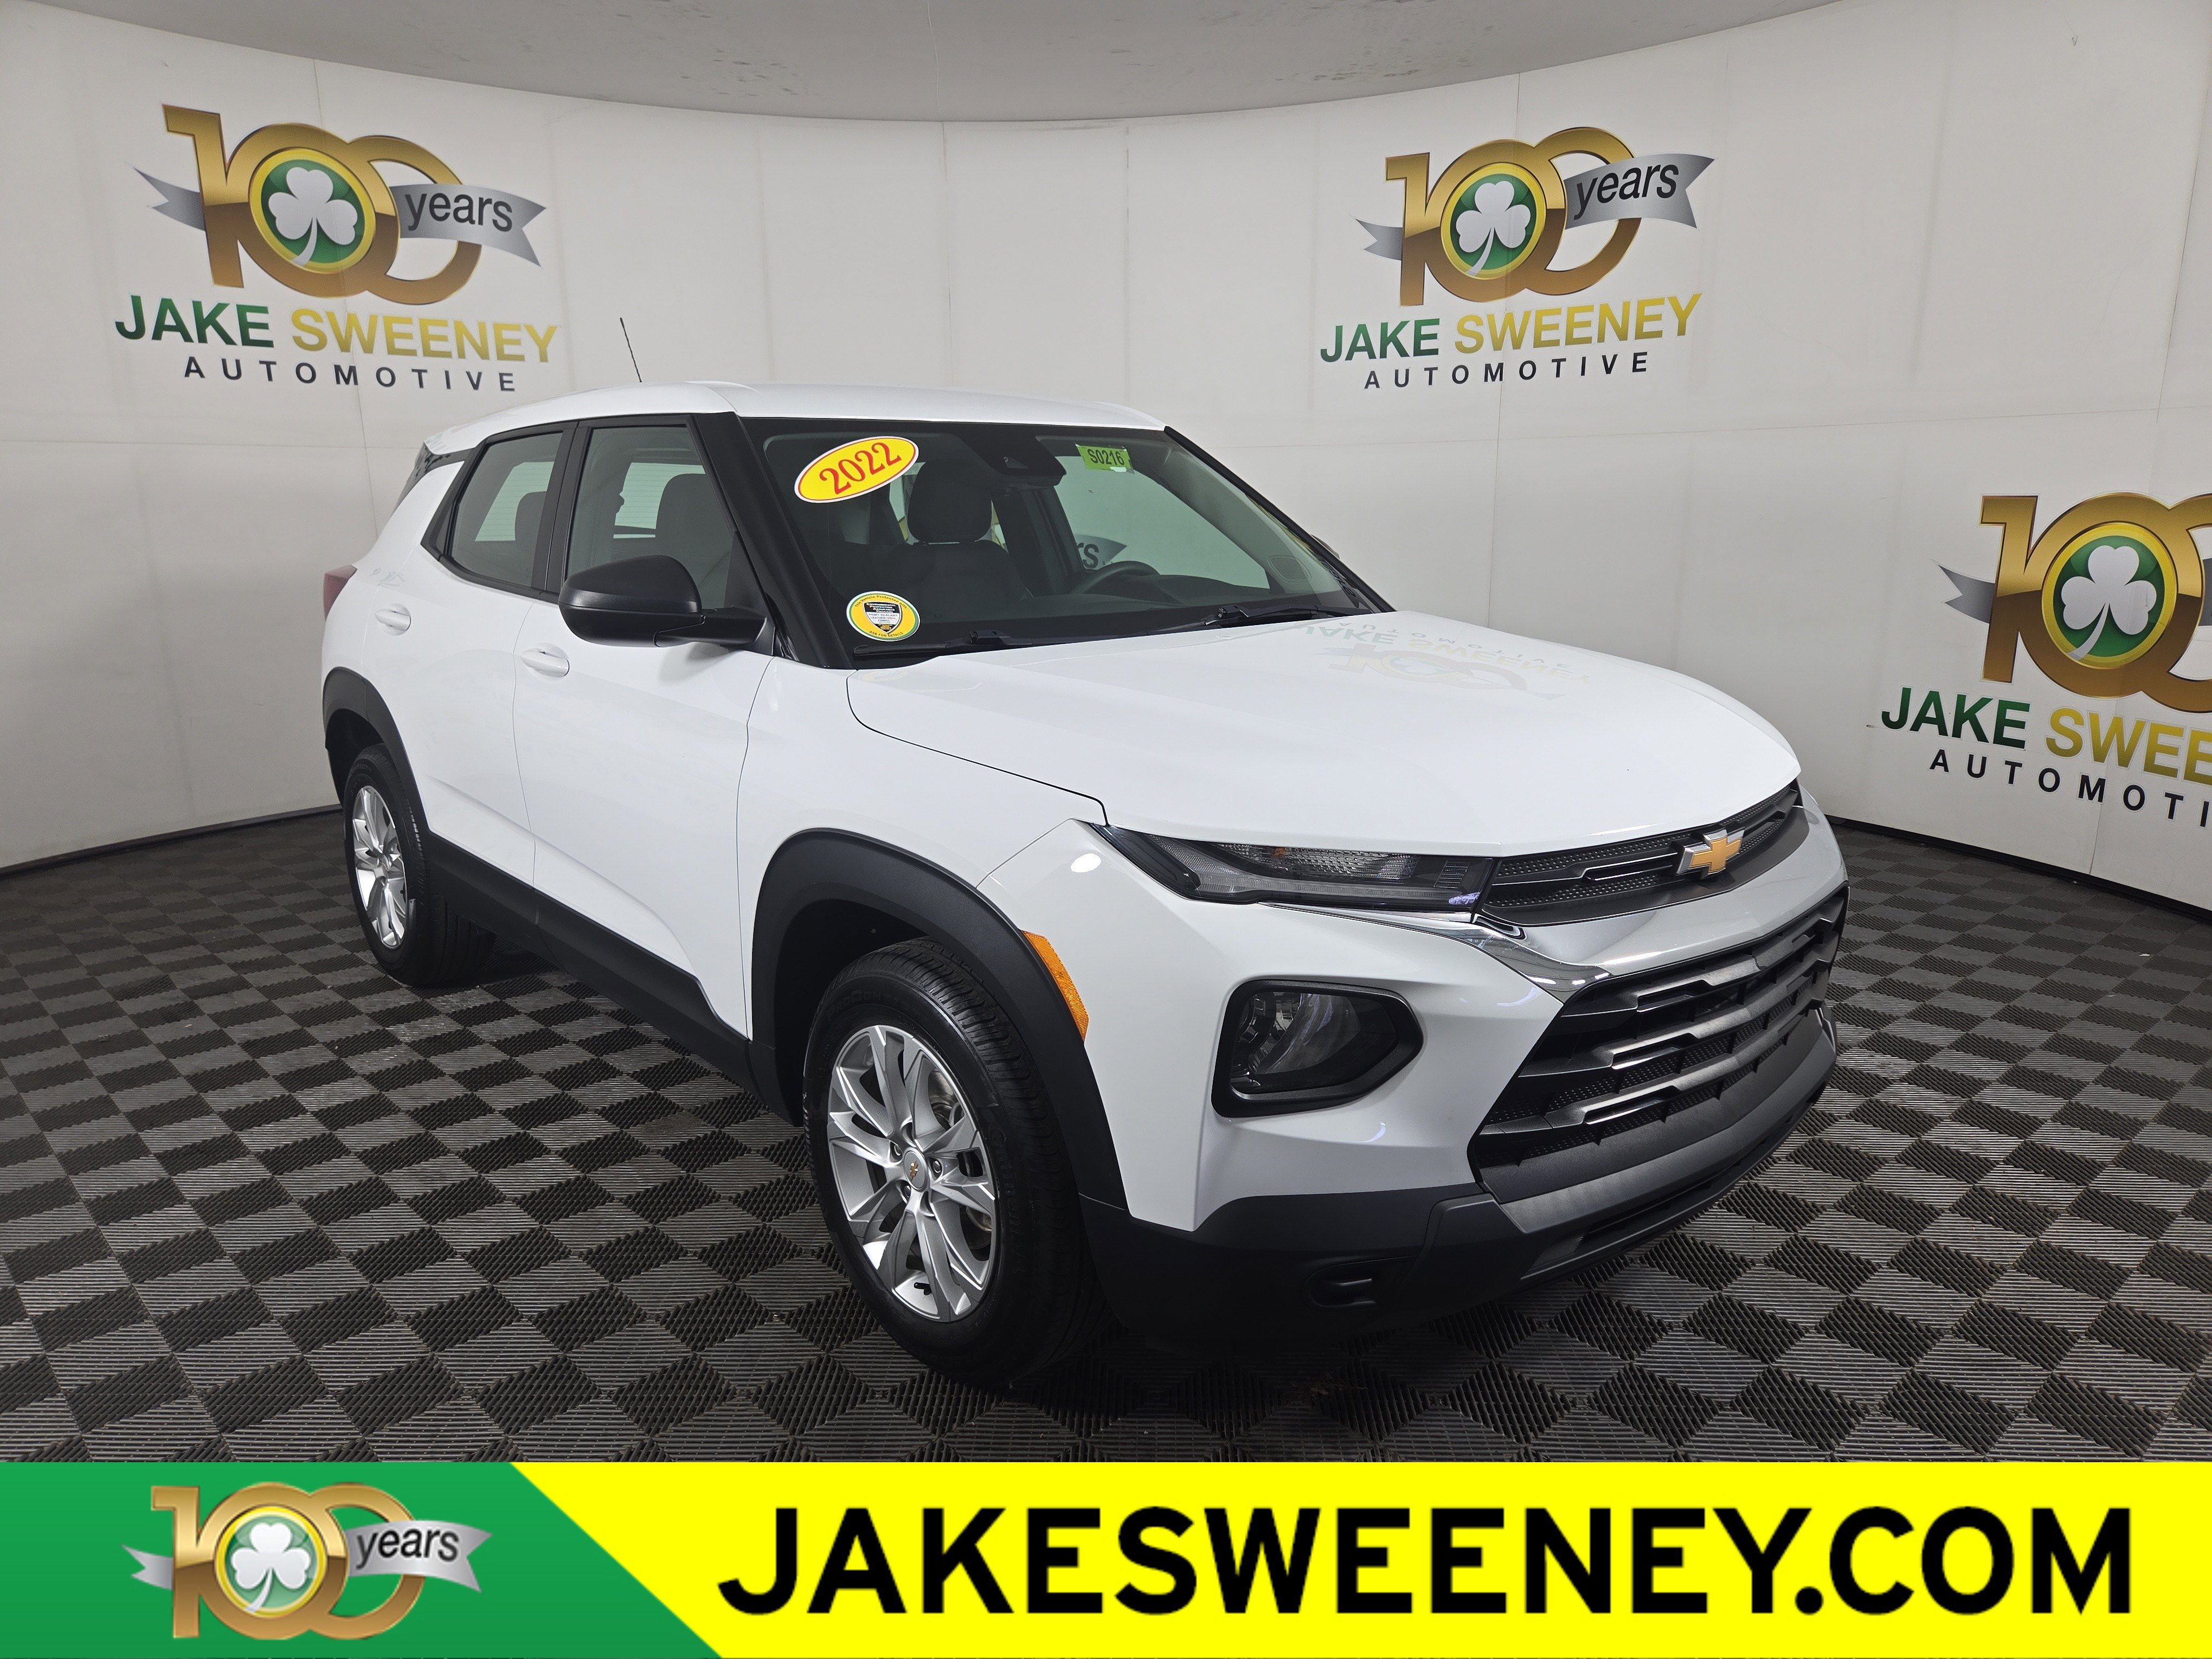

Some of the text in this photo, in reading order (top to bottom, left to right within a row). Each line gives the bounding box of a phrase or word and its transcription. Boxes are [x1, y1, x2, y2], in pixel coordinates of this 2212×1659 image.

[162, 104, 513, 304] 100 years
[1385, 127, 1679, 306] 100 years
[115, 295, 558, 363] JAKE SWEENEY
[1320, 293, 1702, 362] JAKE SWEENEY
[184, 356, 515, 391] AUTOMOTIVE
[1364, 351, 1648, 389] AUTOMOTIVE
[819, 441, 901, 494] 2022
[1088, 448, 1125, 466] S0216
[1881, 687, 2030, 749] JAKE
